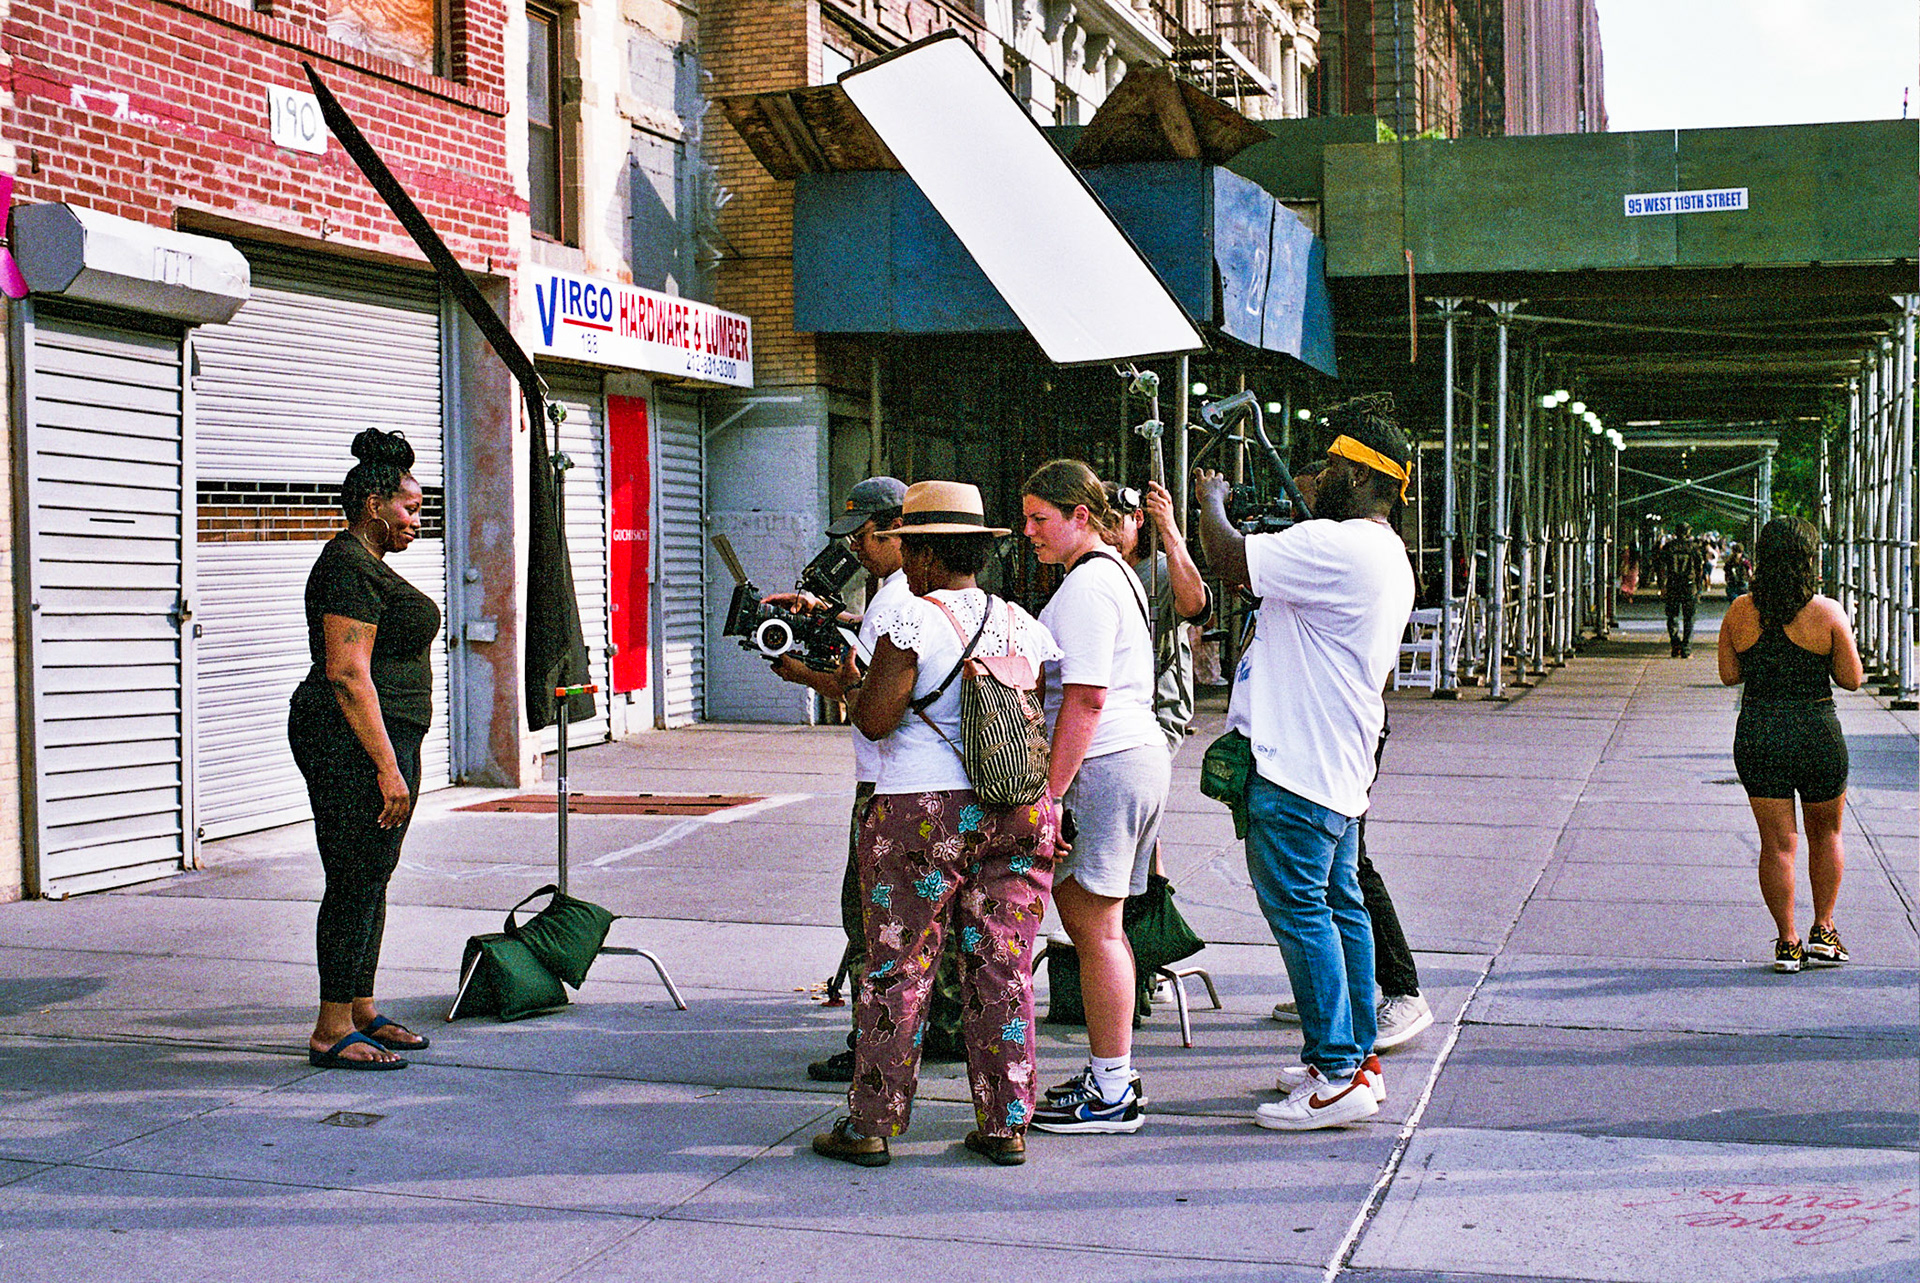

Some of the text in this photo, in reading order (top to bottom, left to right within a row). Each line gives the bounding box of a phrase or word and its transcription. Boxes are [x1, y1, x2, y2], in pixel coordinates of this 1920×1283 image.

[275, 96, 316, 142] 190
[1628, 191, 1742, 214] 95 WEST 119TH STREET
[535, 276, 750, 362] VIRGO HARDWARE & LUMBER
[580, 332, 599, 354] 188
